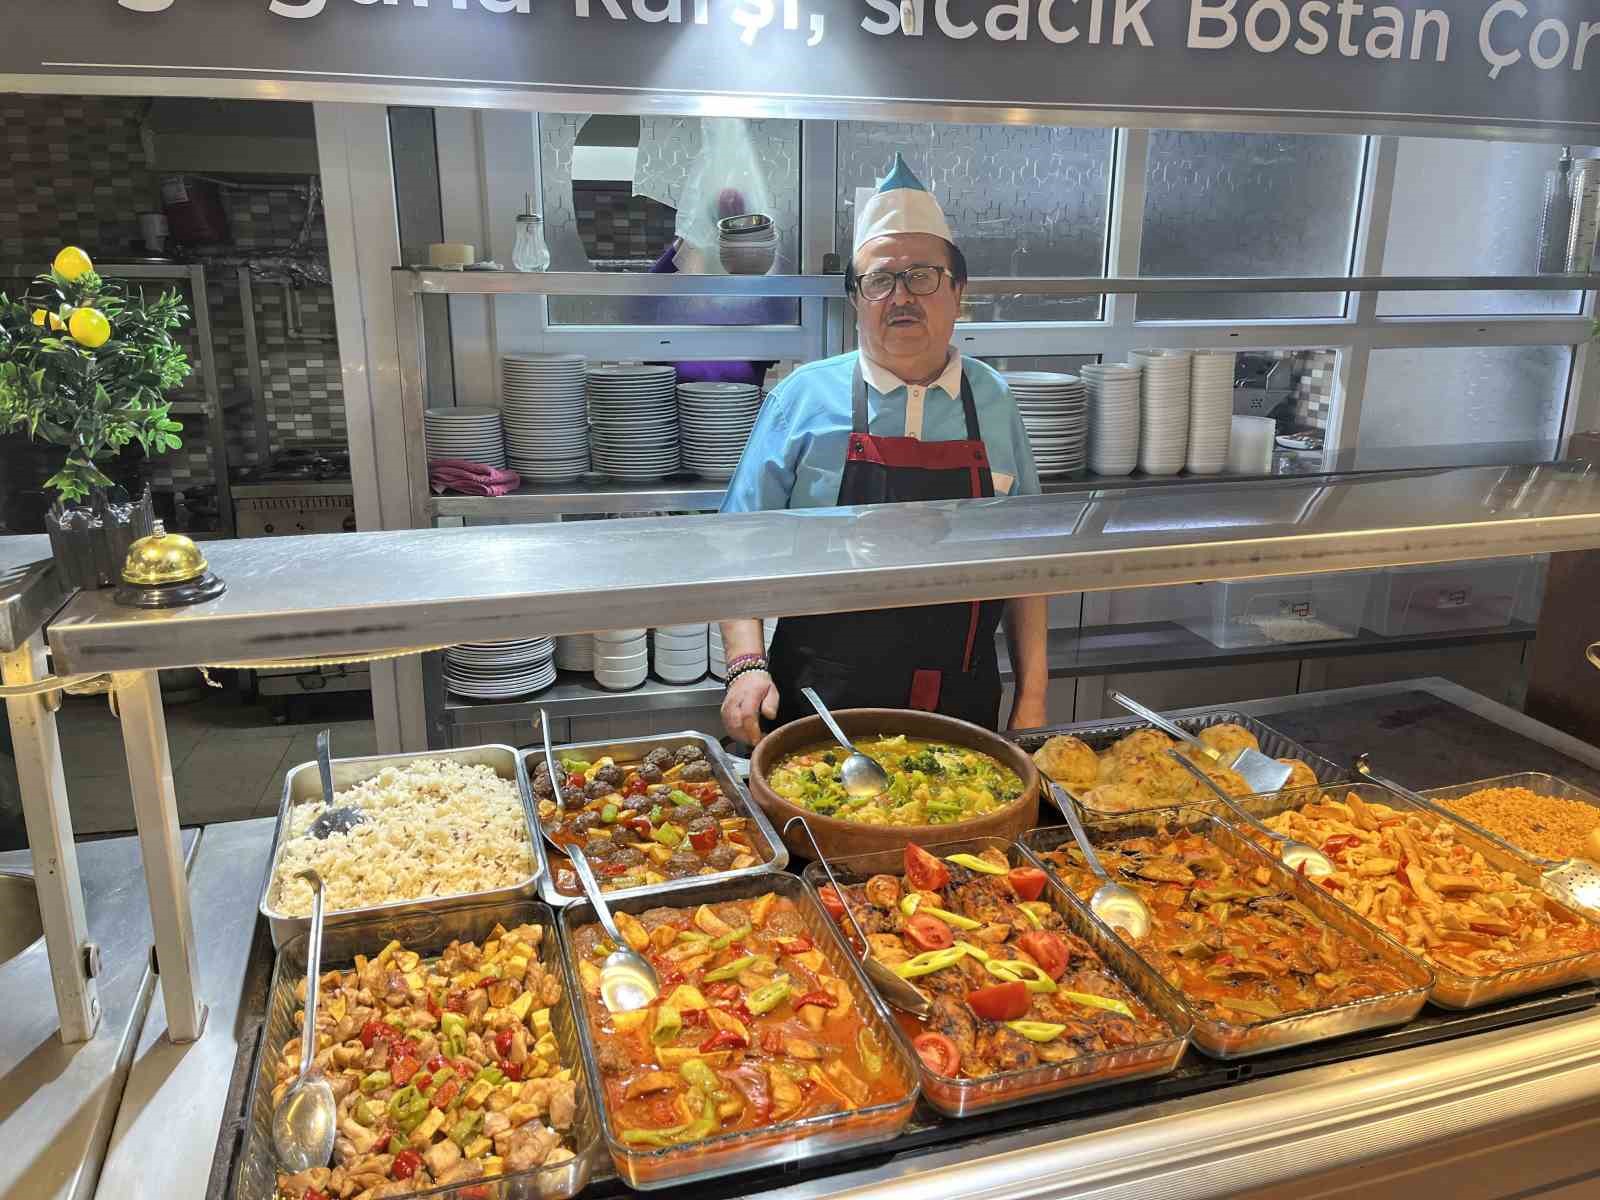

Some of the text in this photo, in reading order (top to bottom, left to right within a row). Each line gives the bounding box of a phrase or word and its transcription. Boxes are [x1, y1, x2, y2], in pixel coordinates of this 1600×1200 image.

[575, 0, 825, 47] şı,
[1187, 0, 1450, 62] Bostan
[1478, 0, 1600, 80] Çor
